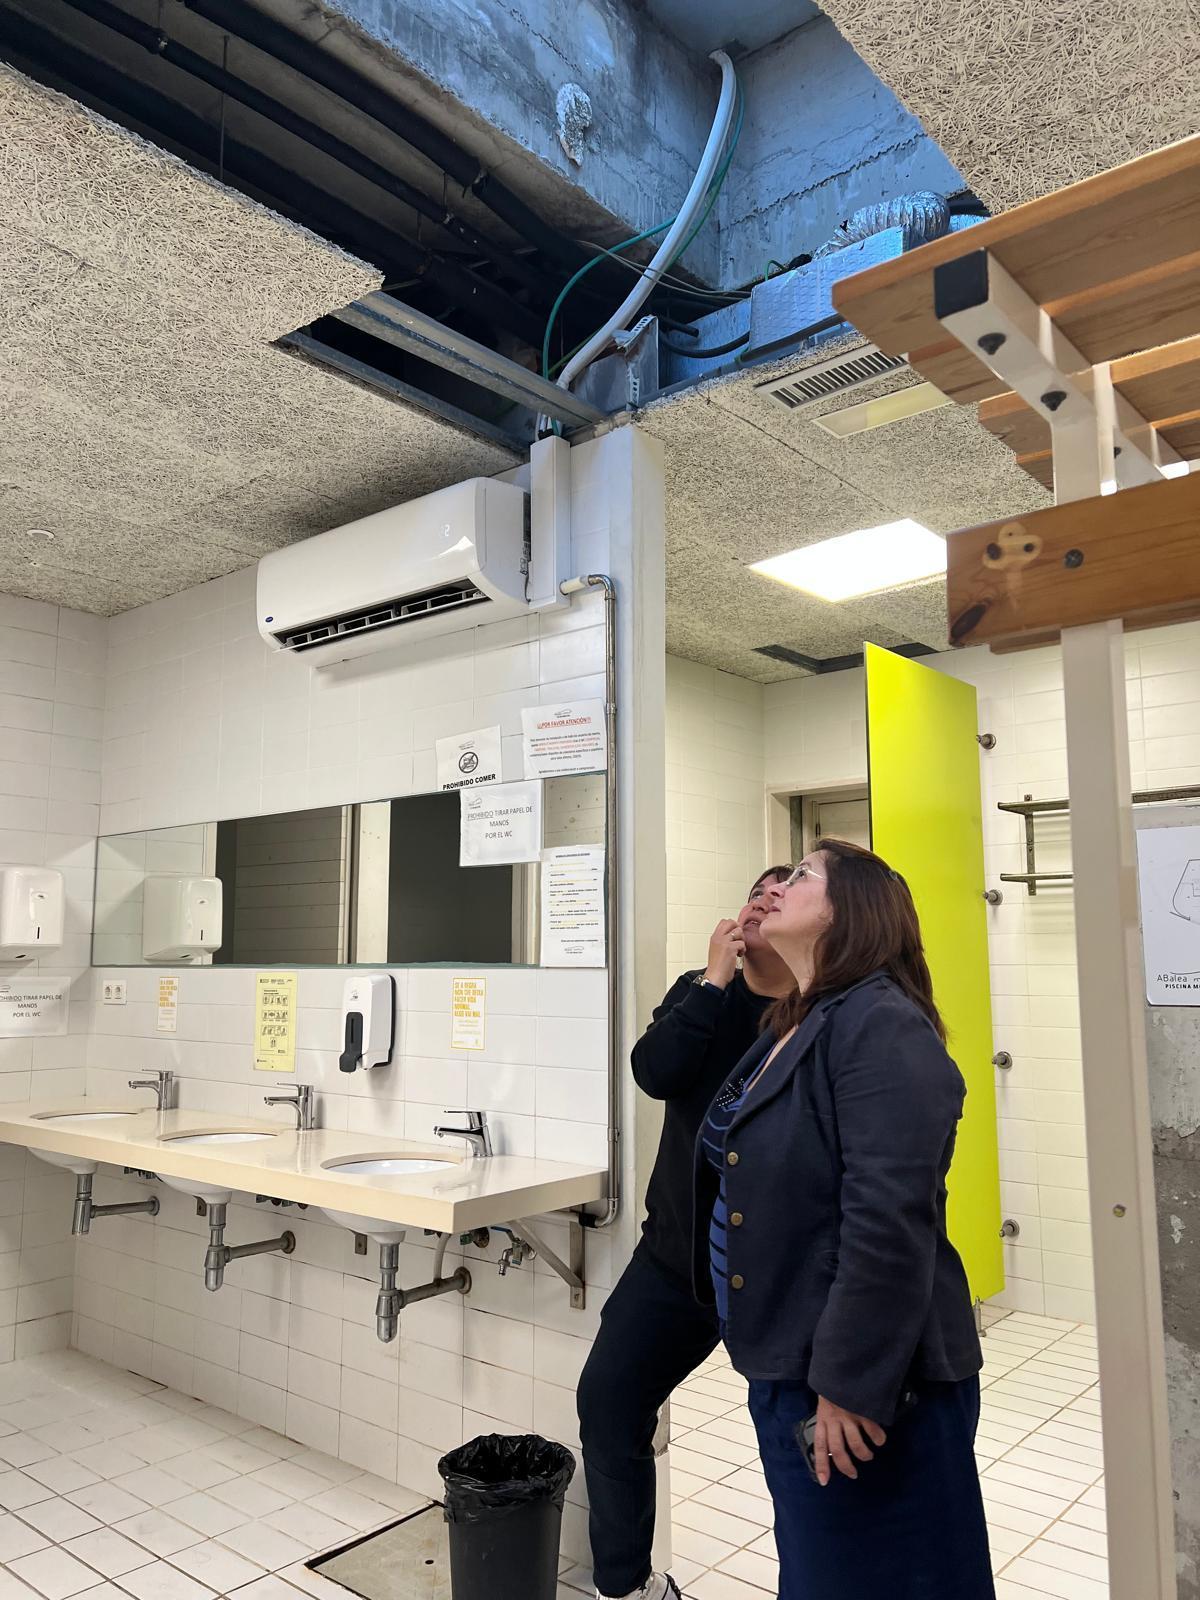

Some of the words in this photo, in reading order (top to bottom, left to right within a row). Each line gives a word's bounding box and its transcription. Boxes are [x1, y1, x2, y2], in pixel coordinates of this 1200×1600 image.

[442, 778, 474, 790] PROHIBIDO
[474, 774, 496, 784] COMER
[468, 810, 494, 820] PROHIBIDO
[495, 808, 509, 816] TIRAR
[490, 819, 509, 827] MANOS
[1157, 974, 1188, 982] ABalea
